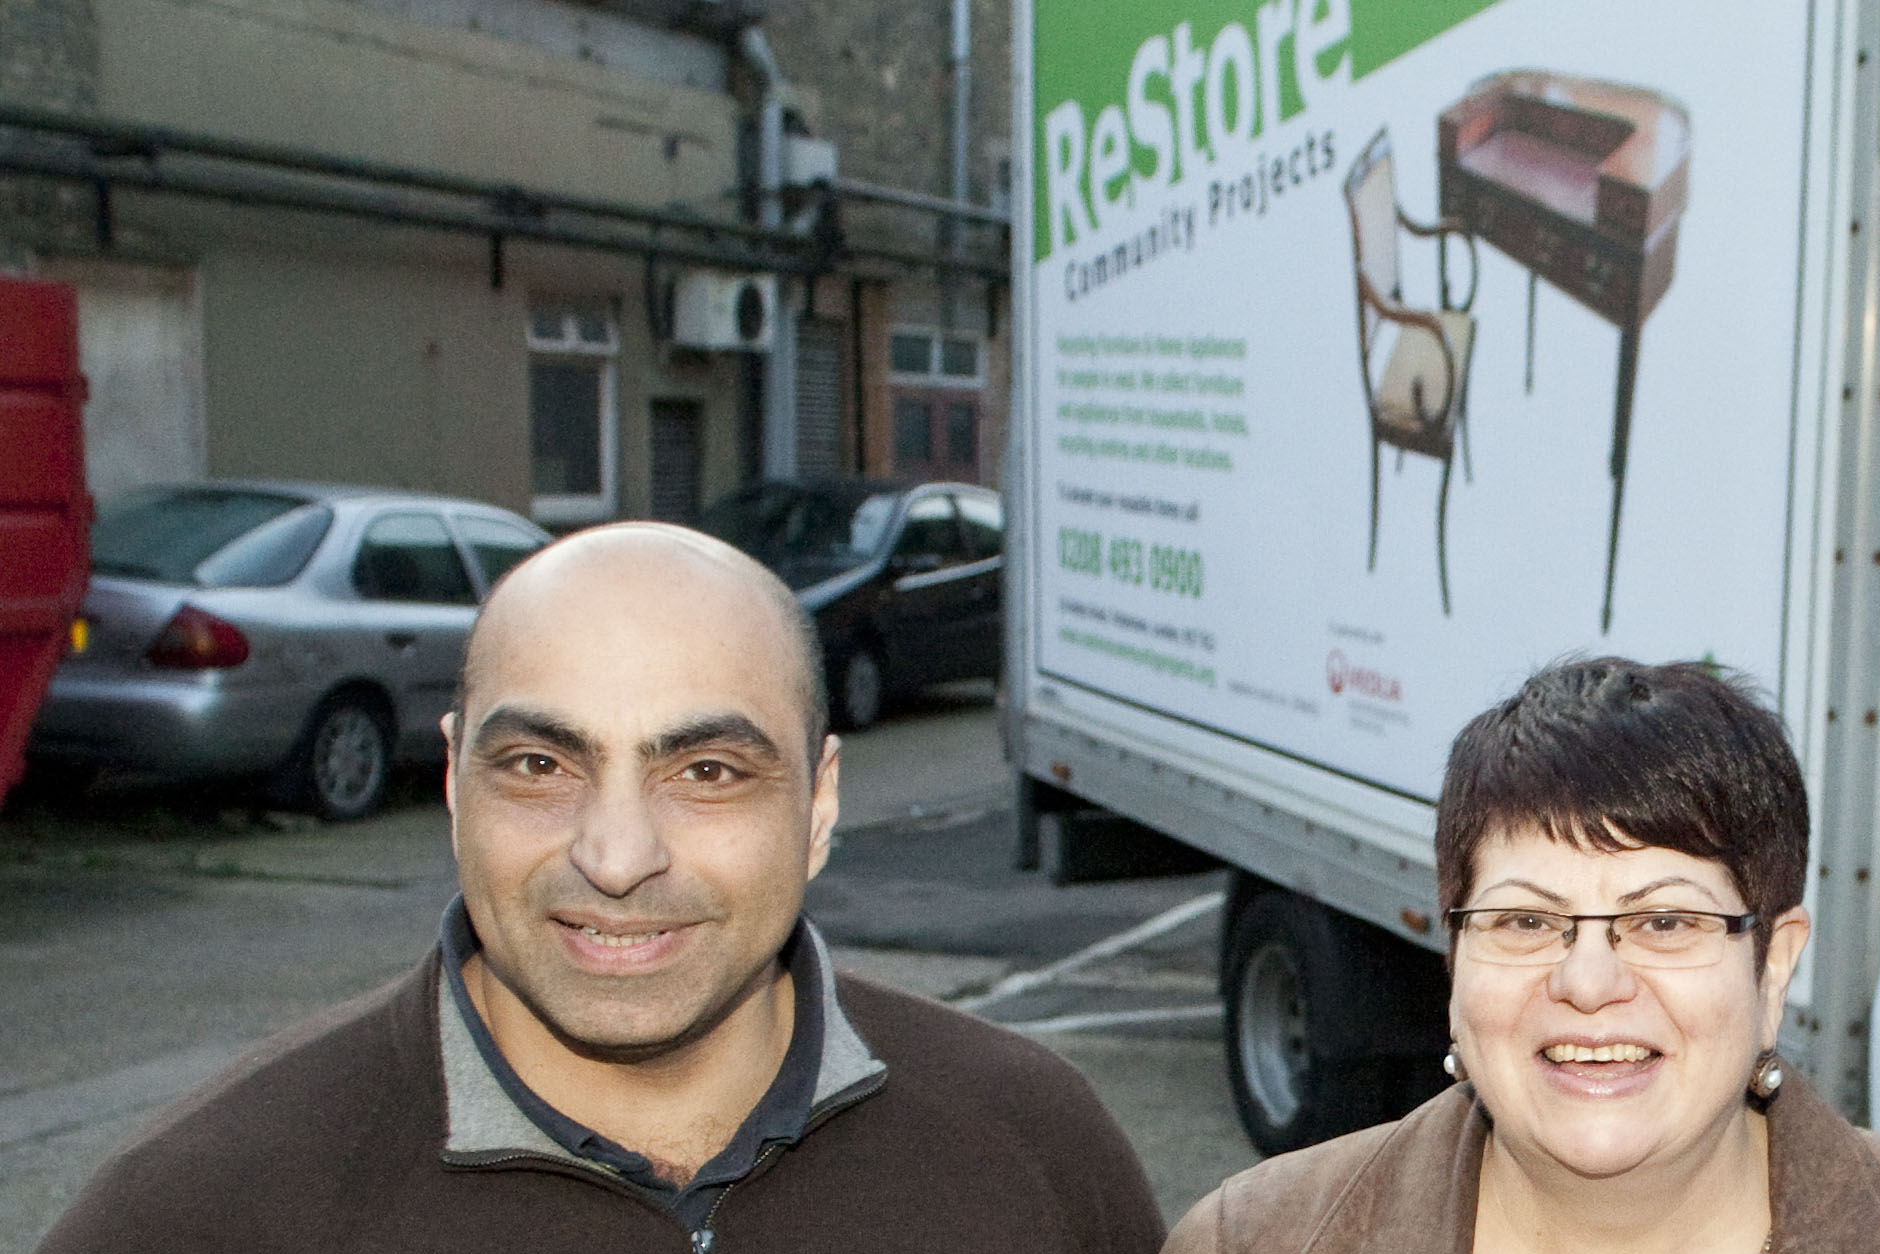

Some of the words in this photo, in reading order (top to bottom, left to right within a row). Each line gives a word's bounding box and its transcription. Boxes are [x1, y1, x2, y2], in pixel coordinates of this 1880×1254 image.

[1044, 0, 1352, 255] ReStore
[1065, 203, 1197, 302] Community
[1208, 130, 1335, 226] Projects
